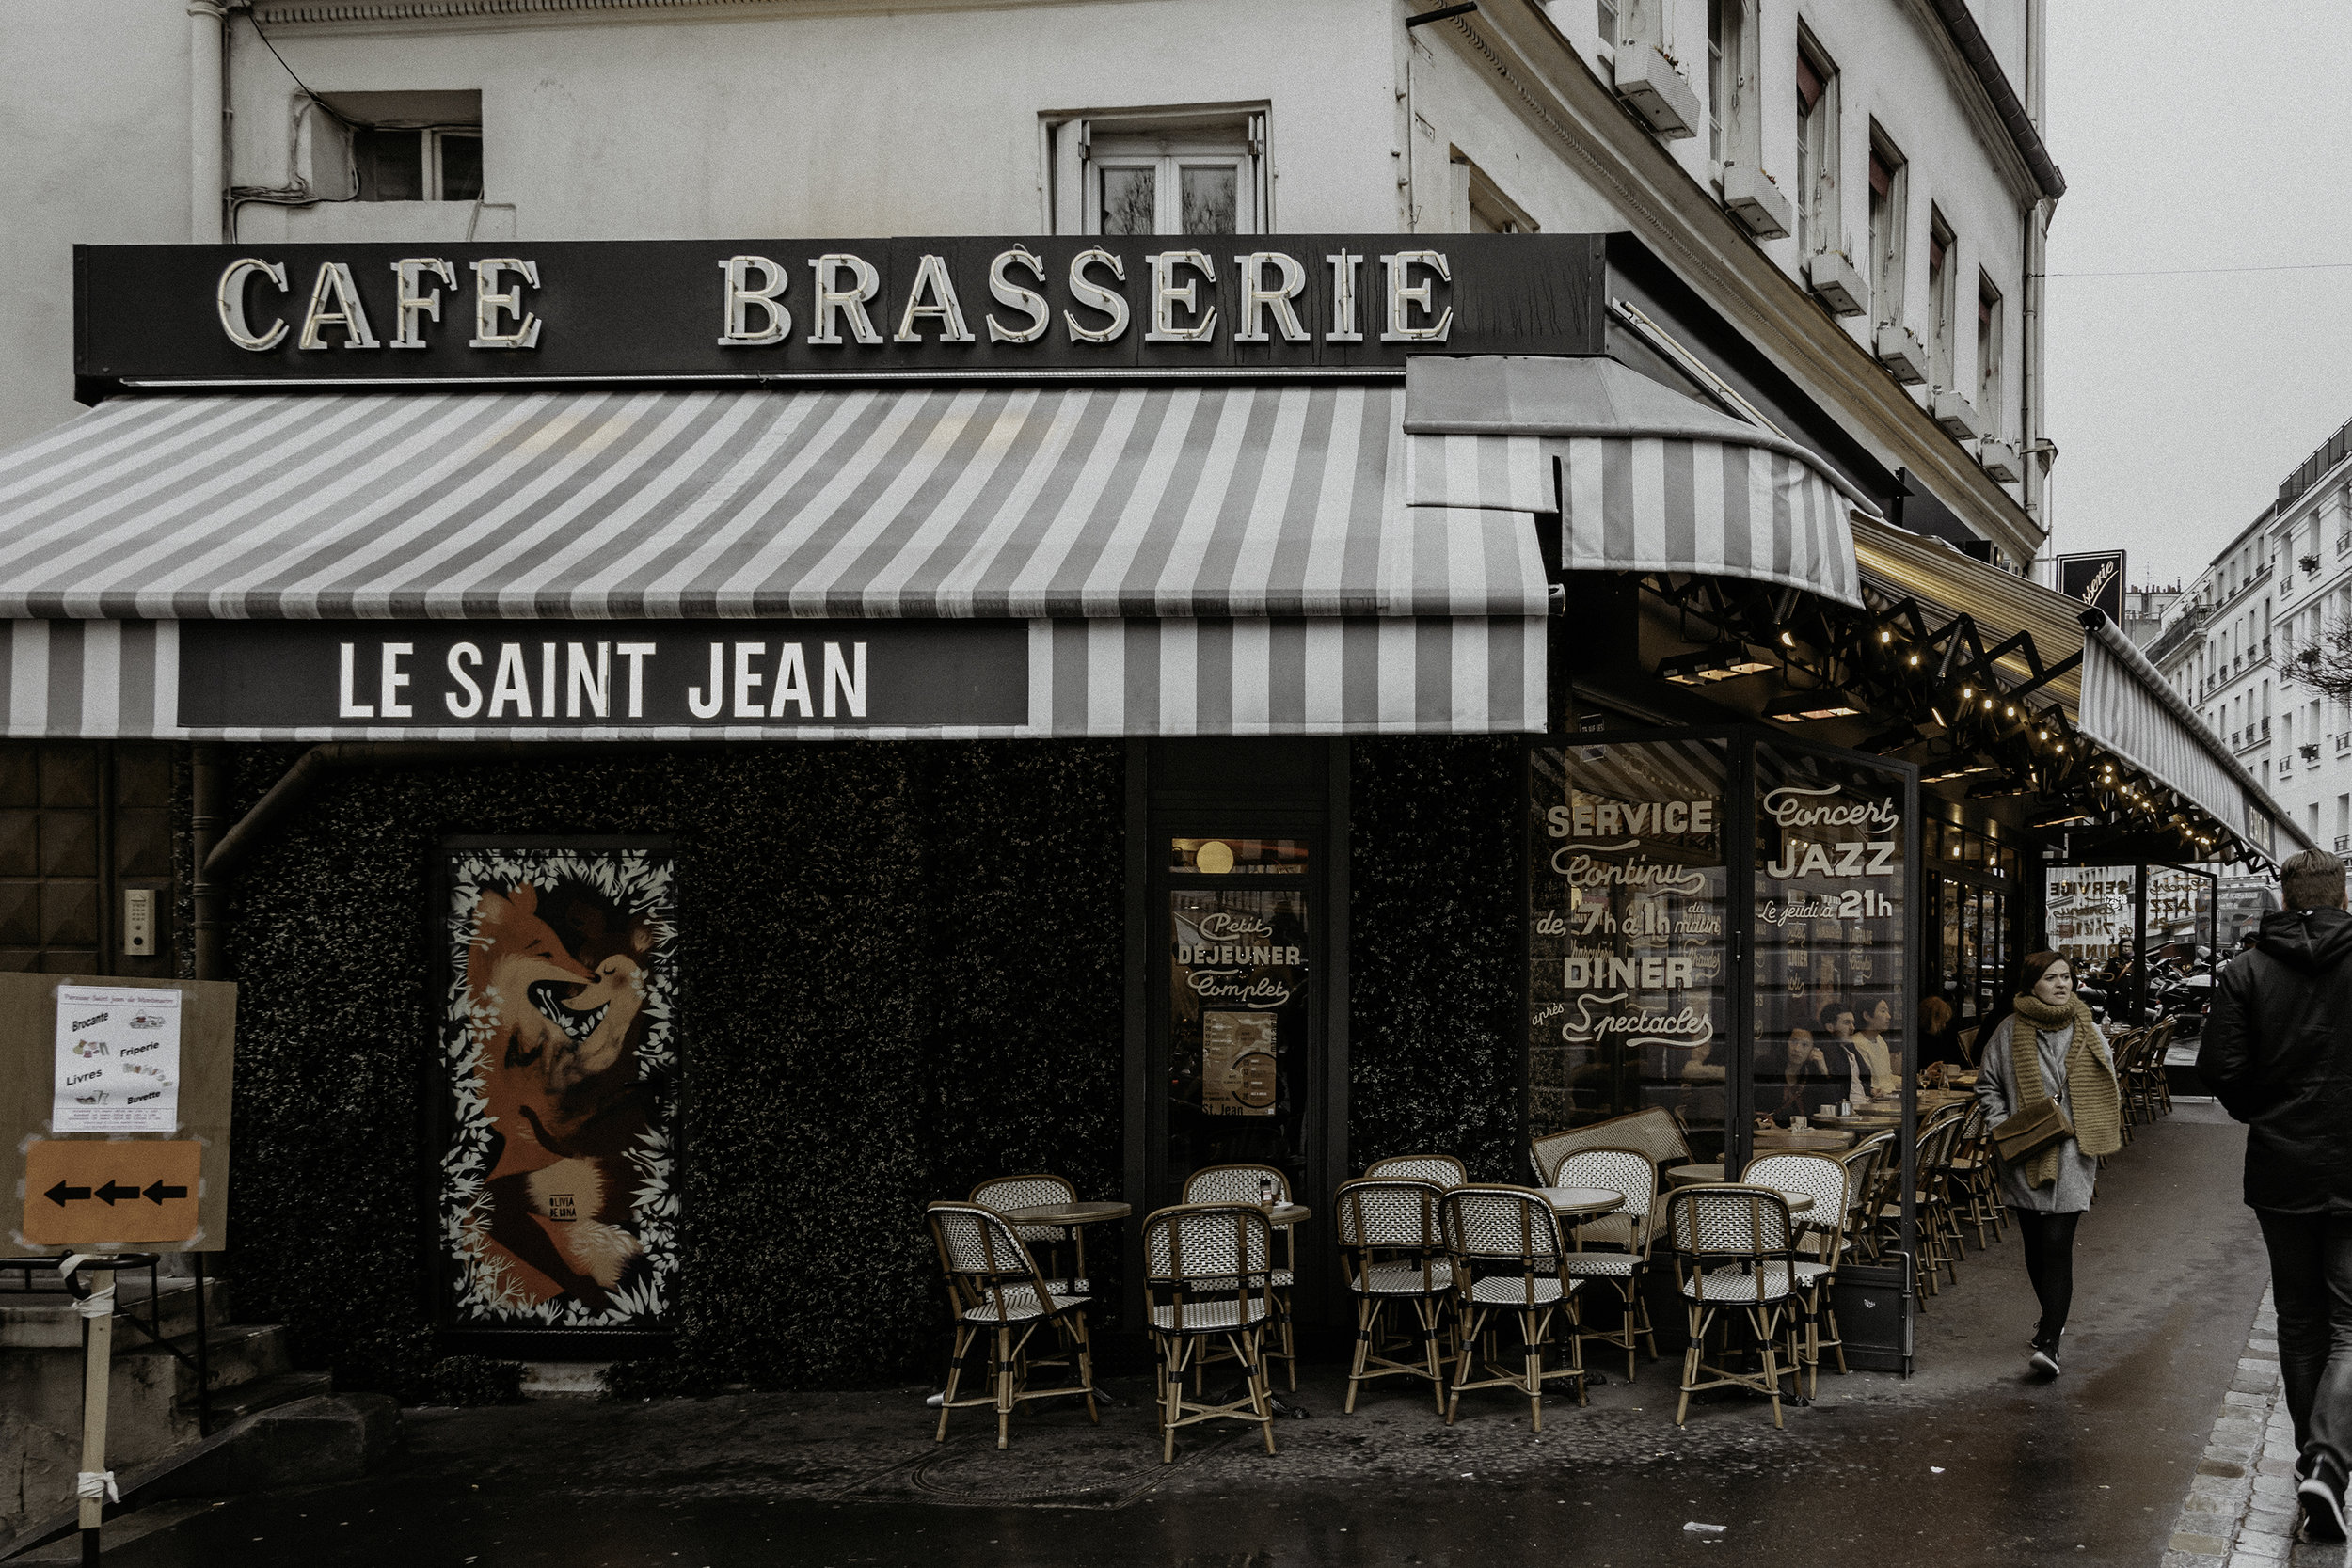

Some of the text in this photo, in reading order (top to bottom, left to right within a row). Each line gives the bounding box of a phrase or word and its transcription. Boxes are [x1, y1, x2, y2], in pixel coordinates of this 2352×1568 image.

[216, 245, 1454, 352] CAFE BRASSERIE
[339, 641, 868, 720] LE SAINT JEAN
[1548, 800, 1713, 838] SERVICE
[1763, 784, 1899, 834] Concert
[1551, 839, 1706, 898] Continu
[1766, 841, 1896, 879] JAZZ
[1536, 909, 1566, 937] de
[1577, 903, 1617, 935] 7h
[1688, 901, 1706, 914] du
[1756, 899, 1777, 923] Le
[1777, 901, 1819, 927] jeudi
[1836, 889, 1893, 919] 21h
[1198, 912, 1273, 942] Petit
[1187, 969, 1291, 1008] Complet
[1564, 957, 1693, 990] DINER
[72, 1011, 109, 1032] Brocante
[1562, 993, 1714, 1047] Spectacles
[120, 1042, 160, 1057] Friperie
[66, 1069, 103, 1086] Livres
[127, 1091, 162, 1104] Buvette
[549, 1197, 575, 1207] OLIVIA
